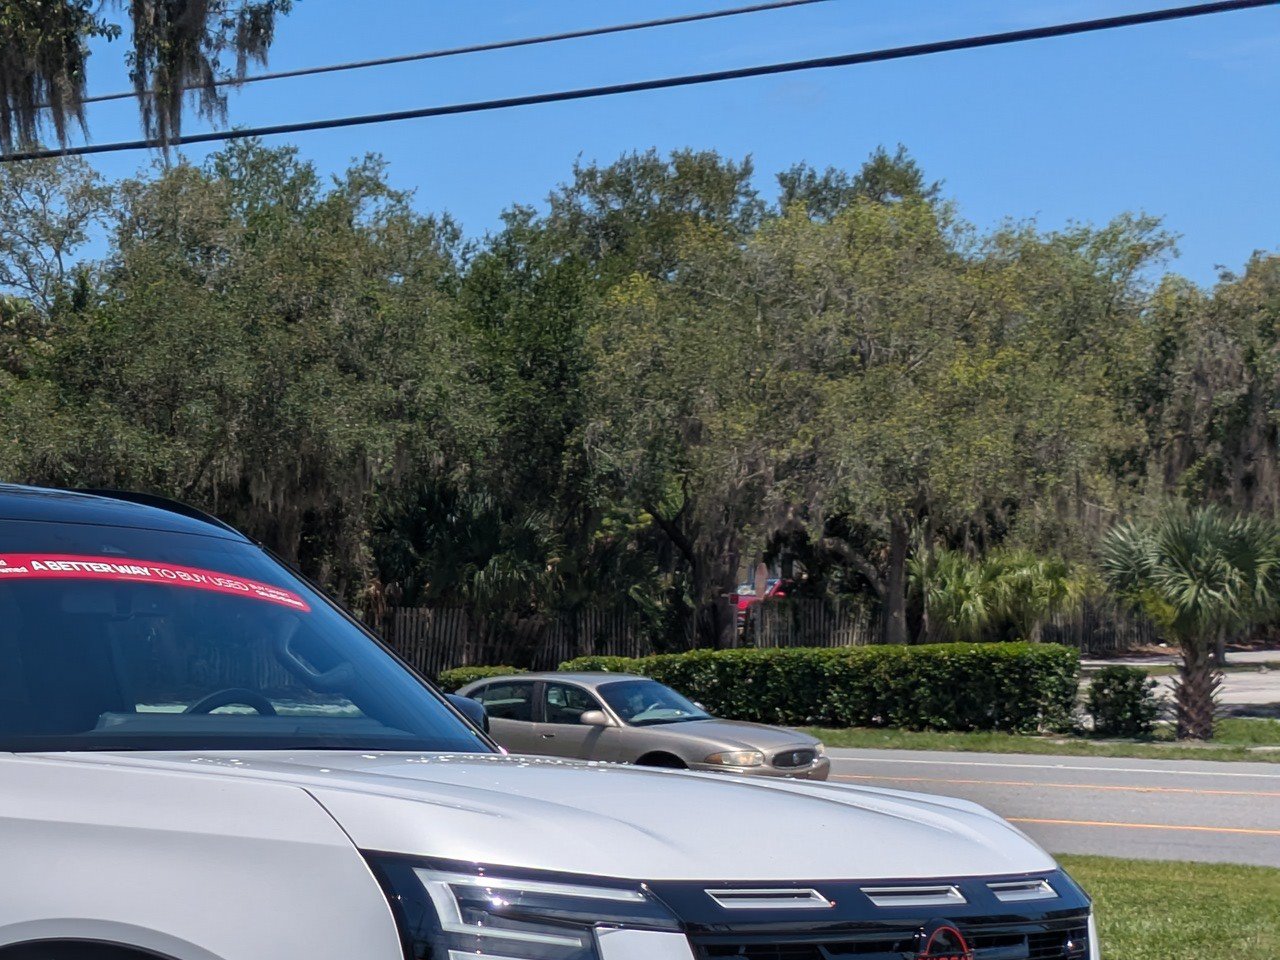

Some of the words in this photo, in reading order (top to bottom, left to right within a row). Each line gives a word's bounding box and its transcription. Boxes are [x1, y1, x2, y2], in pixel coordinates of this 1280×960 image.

[31, 561, 44, 571] A
[44, 561, 114, 573] BETTER
[114, 565, 150, 576] WAY
[150, 568, 176, 579] TO
[176, 571, 208, 583] BUY
[207, 576, 249, 591] USED
